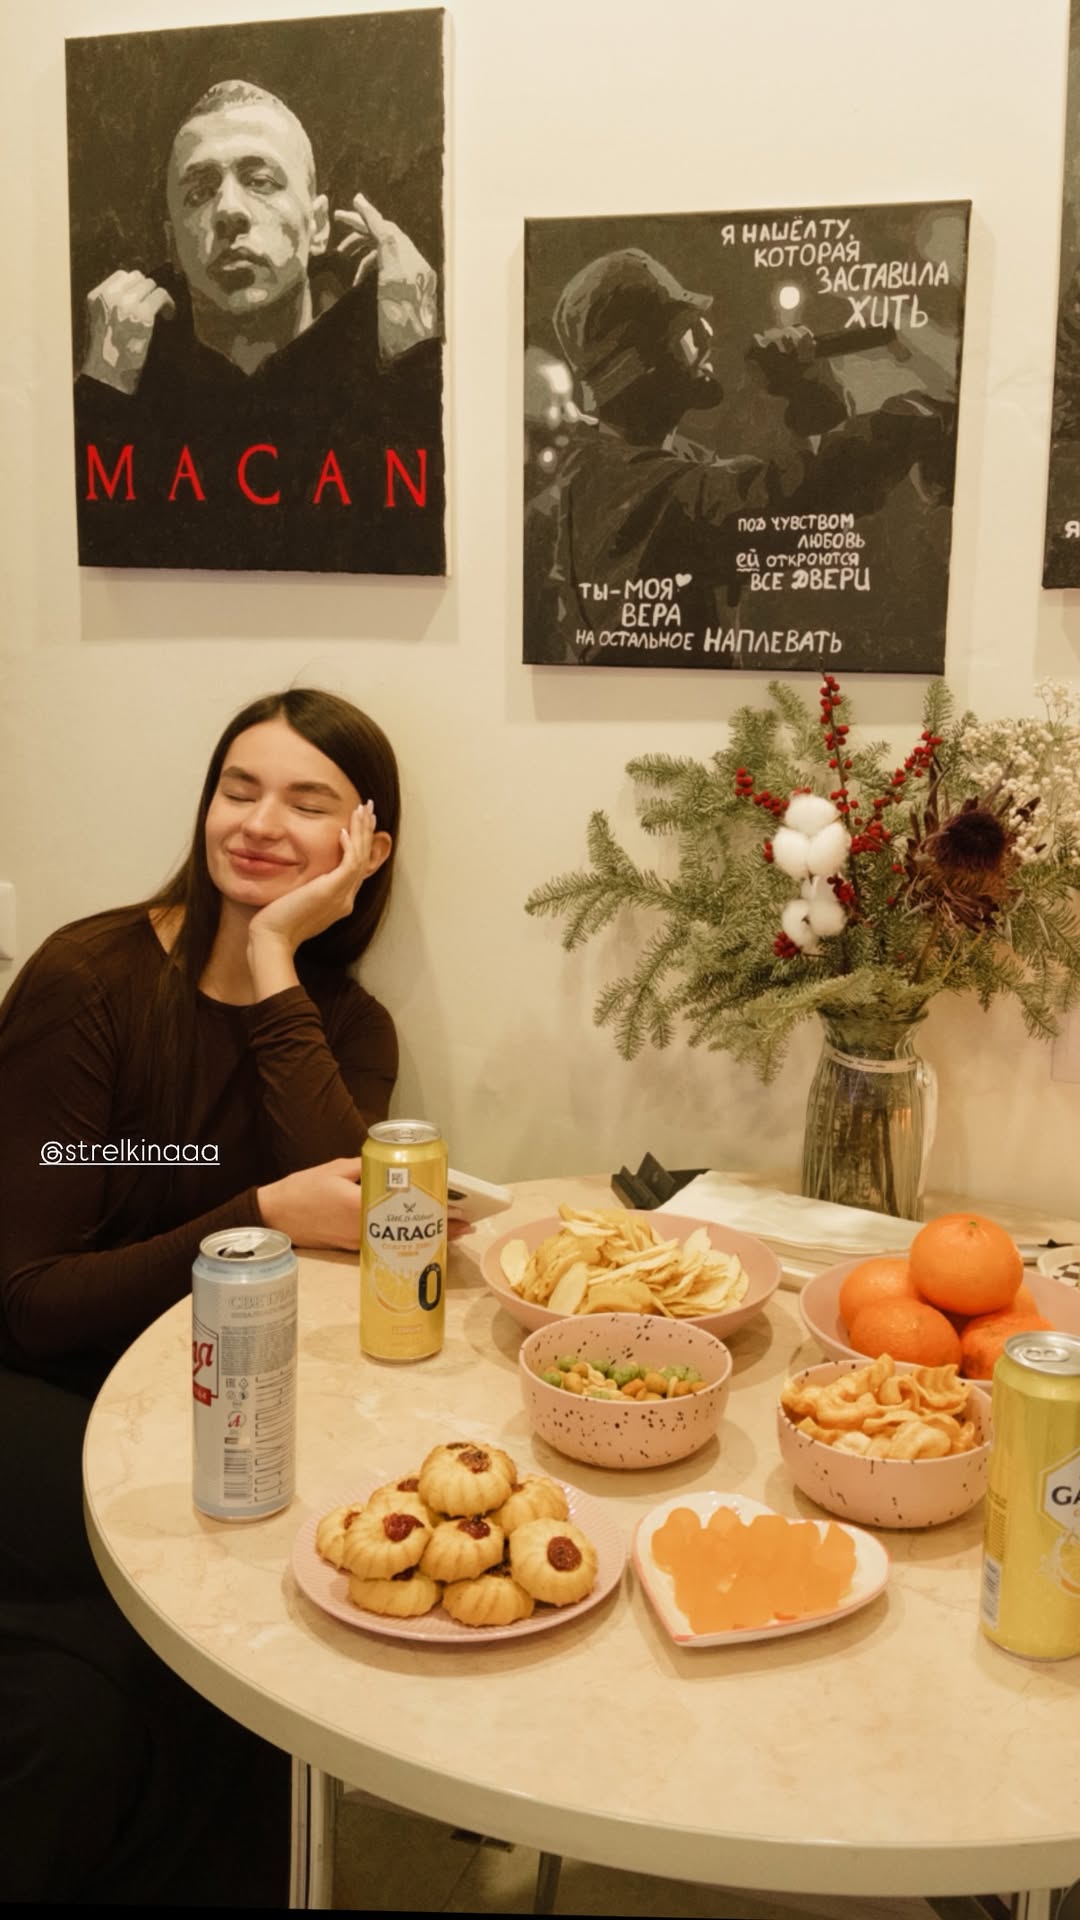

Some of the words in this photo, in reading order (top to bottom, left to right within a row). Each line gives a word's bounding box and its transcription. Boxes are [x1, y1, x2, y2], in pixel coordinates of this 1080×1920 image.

[721, 224, 736, 246] Я
[742, 216, 817, 243] НАШЁЛ
[754, 240, 861, 268] КОТОРАЯ
[816, 260, 950, 294] ЗАСТАВИЛА
[844, 294, 929, 330] ЖИТЬ
[86, 443, 428, 508] MACAN
[771, 513, 855, 531] ЧУВСТВОМ
[797, 531, 866, 549] ЛЮБОВЬ
[751, 572, 784, 591] ВСЕ
[791, 567, 870, 591] ДВЕРИ
[621, 603, 681, 627] ВЕРА
[576, 629, 595, 645] НА
[599, 630, 695, 650] ОСТАЛЬНОЕ
[703, 627, 842, 653] НАПЛЕВАТЬ
[369, 1218, 444, 1241] GARAGE
[418, 1262, 442, 1312] 0
